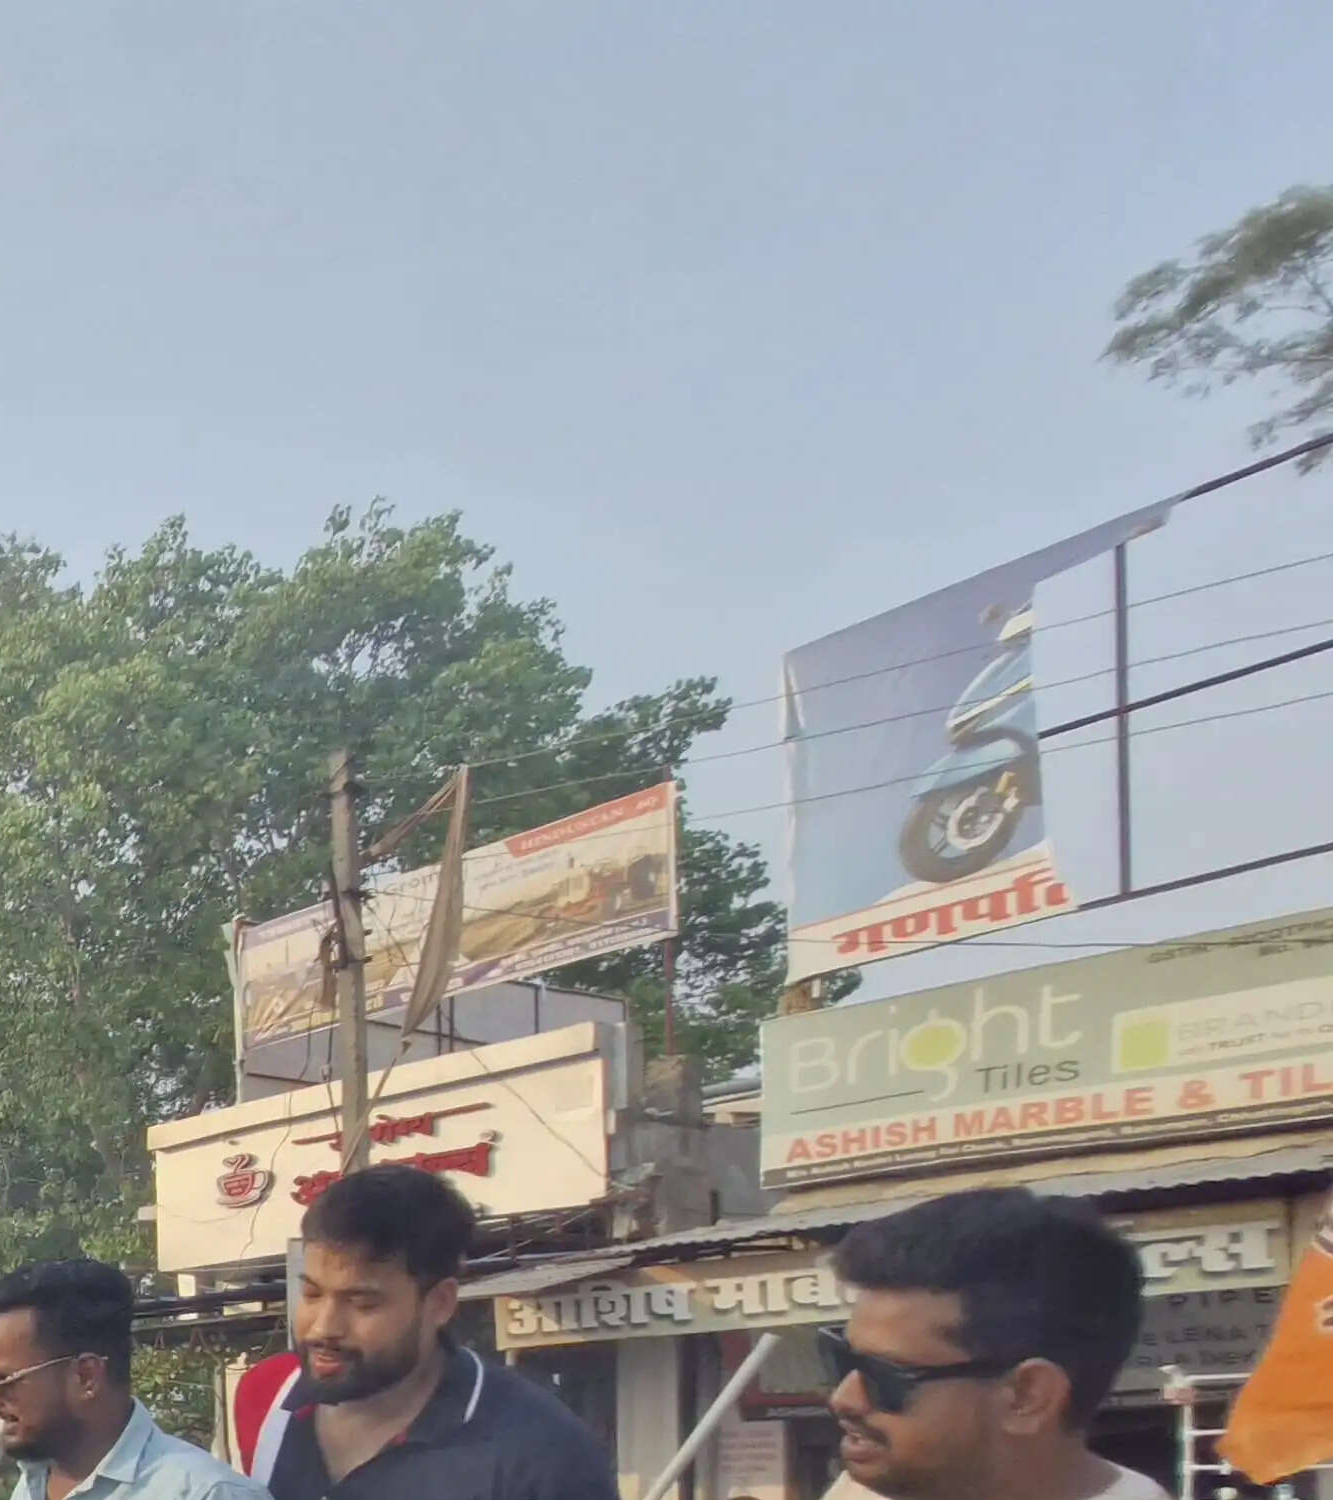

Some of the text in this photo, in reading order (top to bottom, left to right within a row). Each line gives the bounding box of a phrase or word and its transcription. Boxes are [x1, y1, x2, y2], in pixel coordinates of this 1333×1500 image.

[789, 984, 1082, 1102] Bright
[974, 1059, 1080, 1093] Tiles
[785, 1116, 937, 1163] ASHISH
[953, 1086, 1155, 1138] MARBLE
[1176, 1079, 1215, 1110] &
